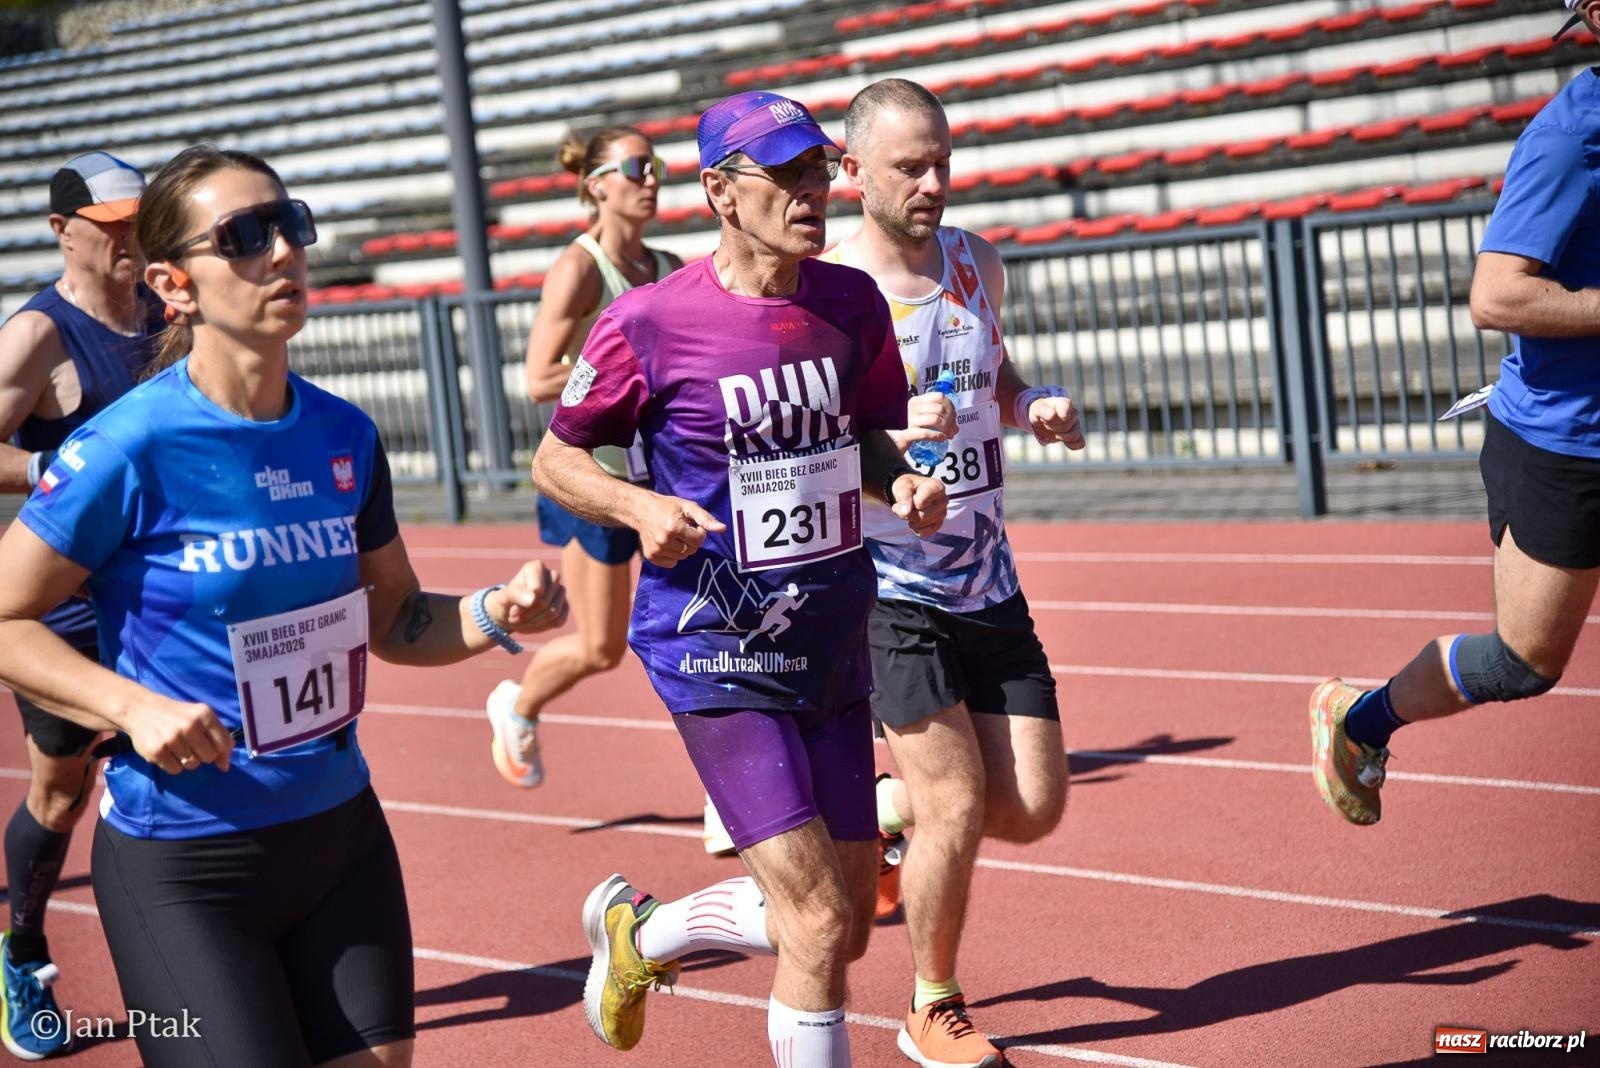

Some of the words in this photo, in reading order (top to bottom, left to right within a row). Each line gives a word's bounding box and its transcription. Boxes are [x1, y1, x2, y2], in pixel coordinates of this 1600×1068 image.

[957, 411, 980, 425] GRANIC
[740, 470, 763, 484] XVIII
[765, 467, 788, 481] BIEG
[790, 464, 807, 478] BEZ
[809, 458, 838, 474] GRANIC
[914, 447, 981, 485] 38
[741, 479, 796, 496] 3MAJA2026
[761, 501, 828, 549] 231
[242, 630, 269, 649] XVIII
[271, 623, 296, 642] BIEG
[298, 618, 316, 635] BEZ
[317, 607, 348, 630] GRANIC
[245, 637, 305, 663] 3MAJA2026
[273, 662, 336, 725] 141
